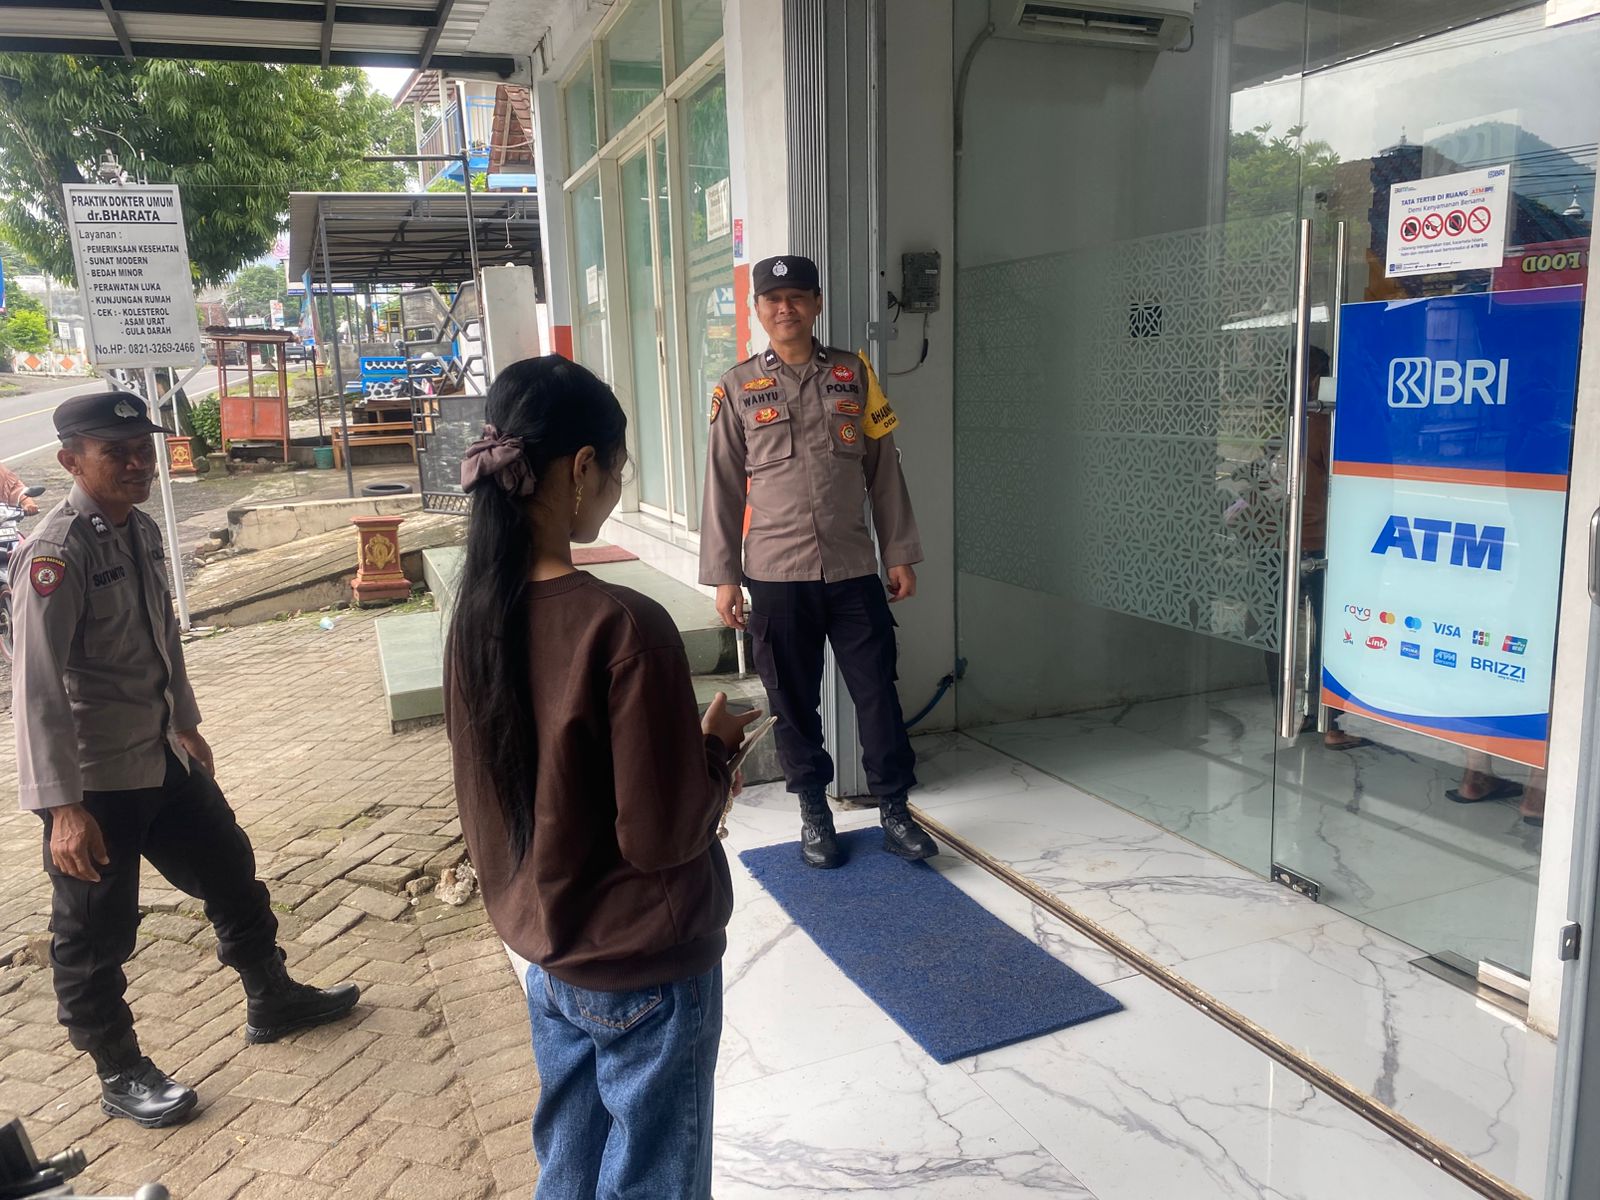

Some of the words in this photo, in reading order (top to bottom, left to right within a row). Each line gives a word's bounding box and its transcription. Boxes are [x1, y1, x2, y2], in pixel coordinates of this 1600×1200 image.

[72, 196, 108, 206] PRAKTIK
[110, 196, 144, 207] DOKTER
[147, 196, 173, 207] UMUM
[1416, 195, 1436, 203] TERTIB
[1445, 190, 1468, 200] RUANG
[1408, 205, 1422, 213] Demi
[1423, 201, 1459, 212] Kenyamanan
[1460, 197, 1486, 206] Bersama
[79, 230, 116, 240] Layanan
[87, 245, 137, 253] PEMERIKSAAN
[139, 245, 179, 253] KESEHATAN
[89, 257, 114, 265] SUNAT
[116, 256, 148, 264] MODERN
[92, 269, 116, 277] BEDAH
[118, 269, 143, 277] MINOR
[94, 283, 140, 291] PERAWATAN
[141, 283, 161, 291] LUKA
[95, 296, 143, 304] KUNJUNGAN
[123, 308, 169, 316] KOLESTEROL
[125, 318, 144, 326] ASAM
[129, 342, 195, 354] 0821-3269-2466
[1433, 359, 1509, 405] BRI
[826, 384, 859, 394] POLRI
[743, 391, 778, 408] WAHYU
[1371, 515, 1505, 571] ATM
[1344, 604, 1371, 617] raya
[1432, 622, 1461, 638] VISA
[1471, 656, 1526, 680] BRIZZI
